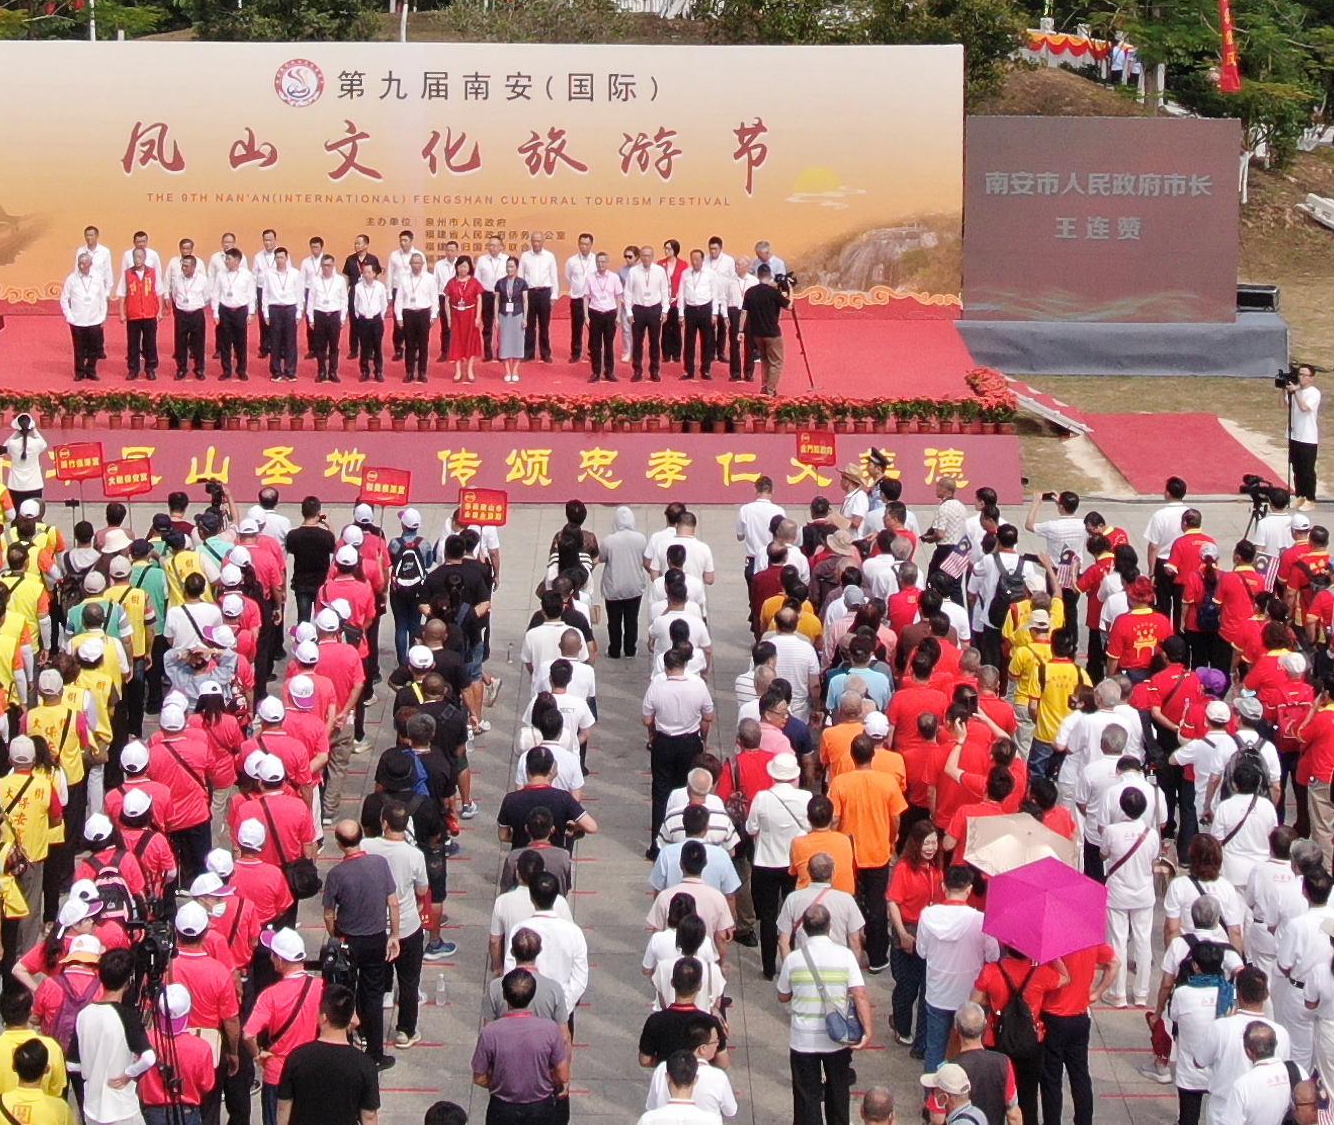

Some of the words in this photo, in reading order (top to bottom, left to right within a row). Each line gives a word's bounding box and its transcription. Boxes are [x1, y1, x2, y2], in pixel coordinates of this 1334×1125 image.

[337, 70, 659, 102] 第九届南安(国际)
[121, 118, 770, 195] 凤山文化旅游节
[984, 171, 1213, 196] 南安市人民政府市长
[148, 193, 172, 201] THE
[216, 194, 405, 203] NAN'AN(INTERNATIONAL)
[414, 195, 492, 204] FENGSHAN
[501, 196, 576, 205] CULTURAL
[586, 197, 651, 205] TOURISM
[660, 198, 729, 206] FESTIVAL
[426, 230, 566, 240] 福建省人民政府侨务公室
